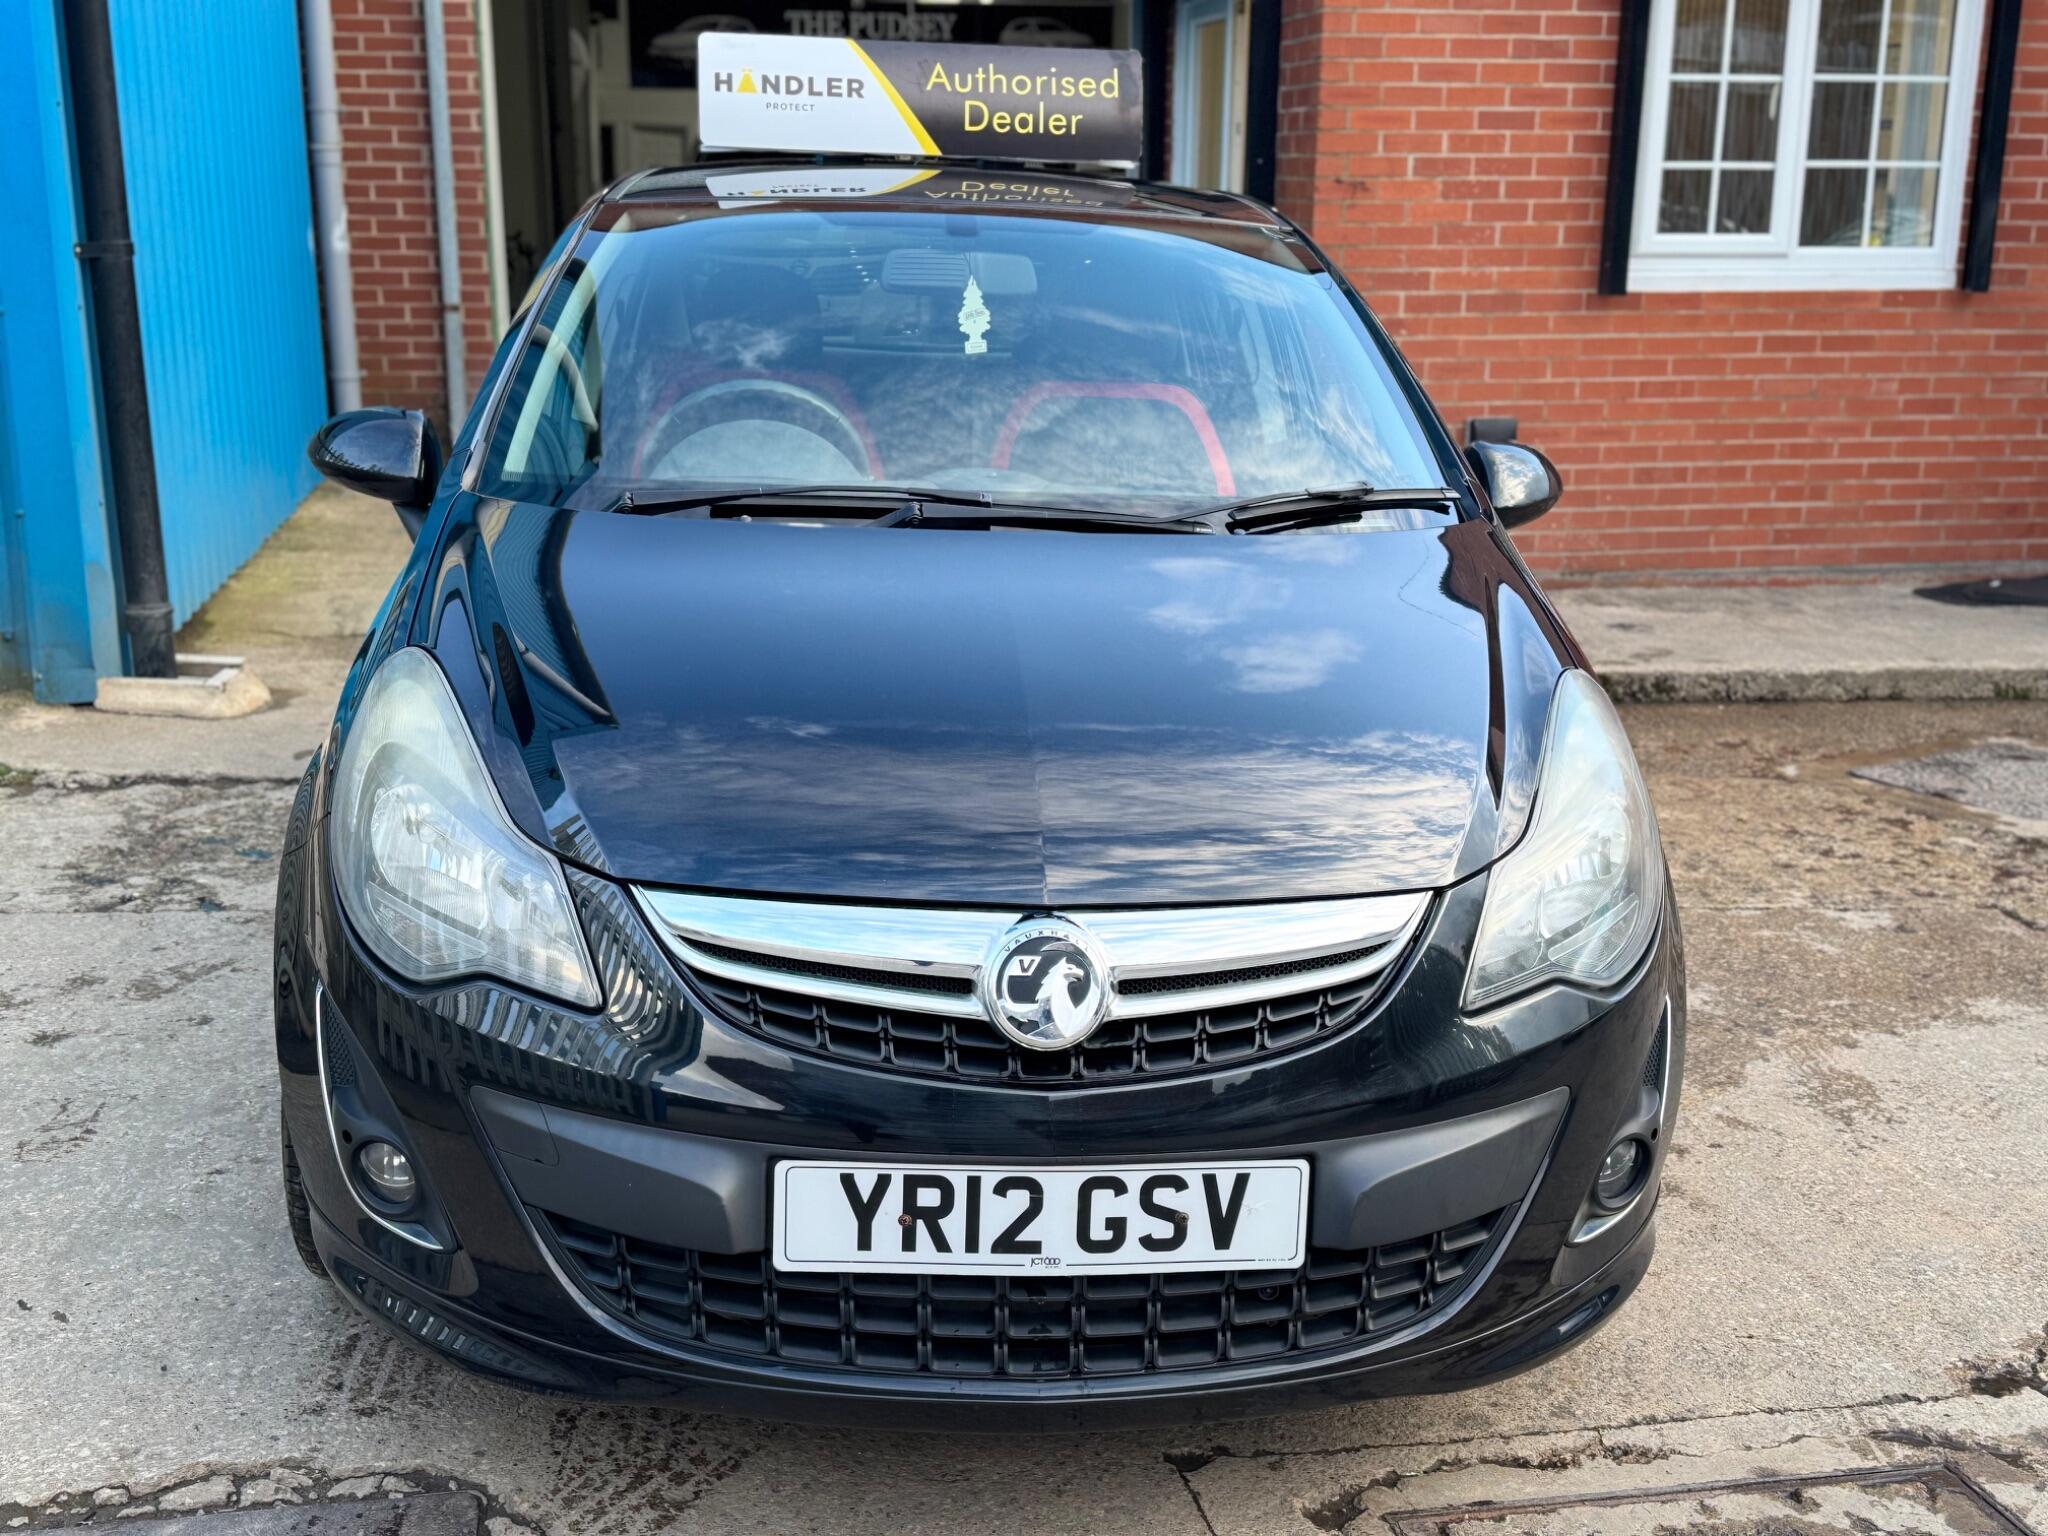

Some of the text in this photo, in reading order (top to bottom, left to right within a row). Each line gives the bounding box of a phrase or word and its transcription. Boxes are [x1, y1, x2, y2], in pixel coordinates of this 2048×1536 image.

[783, 9, 845, 36] THE
[926, 62, 1119, 98] Authorised
[766, 102, 816, 112] PROTECT
[964, 100, 1084, 135] Dealer
[1004, 930, 1089, 953] VAUXHALL
[839, 1172, 1251, 1254] YR12 GSV
